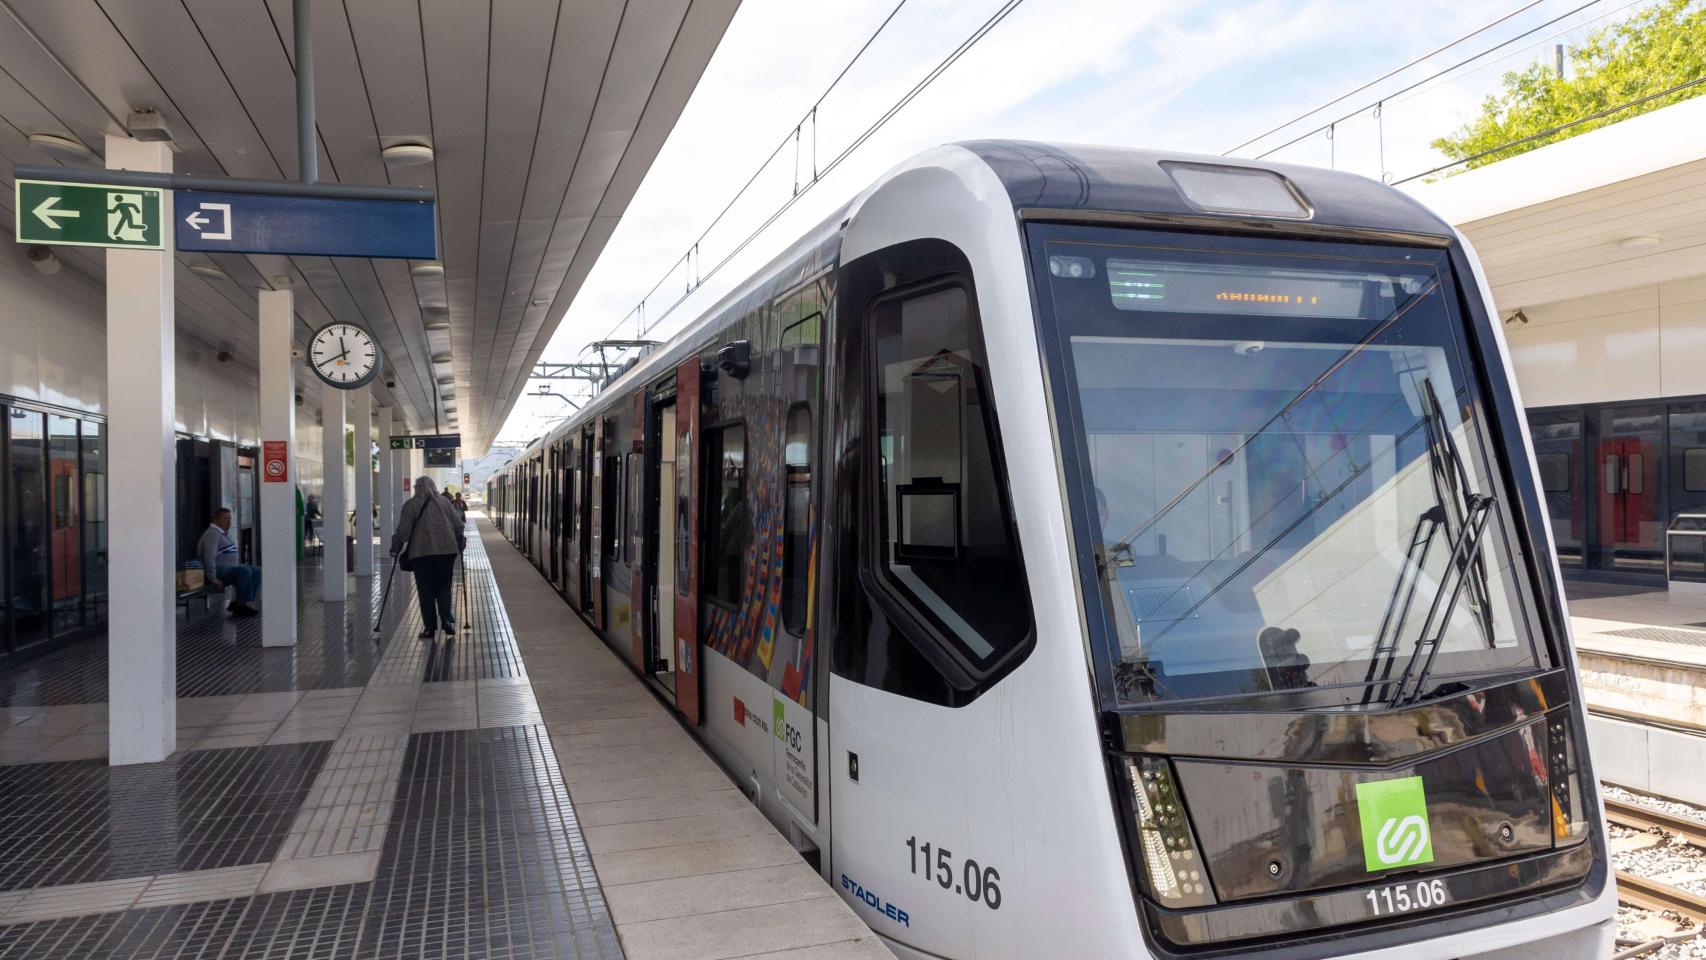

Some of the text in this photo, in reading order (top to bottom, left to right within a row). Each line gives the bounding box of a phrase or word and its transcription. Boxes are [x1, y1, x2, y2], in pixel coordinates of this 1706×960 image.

[786, 722, 802, 753] FGC
[906, 835, 1002, 911] 115.06
[841, 873, 910, 928] STADLER
[1366, 879, 1446, 916] 115.06
